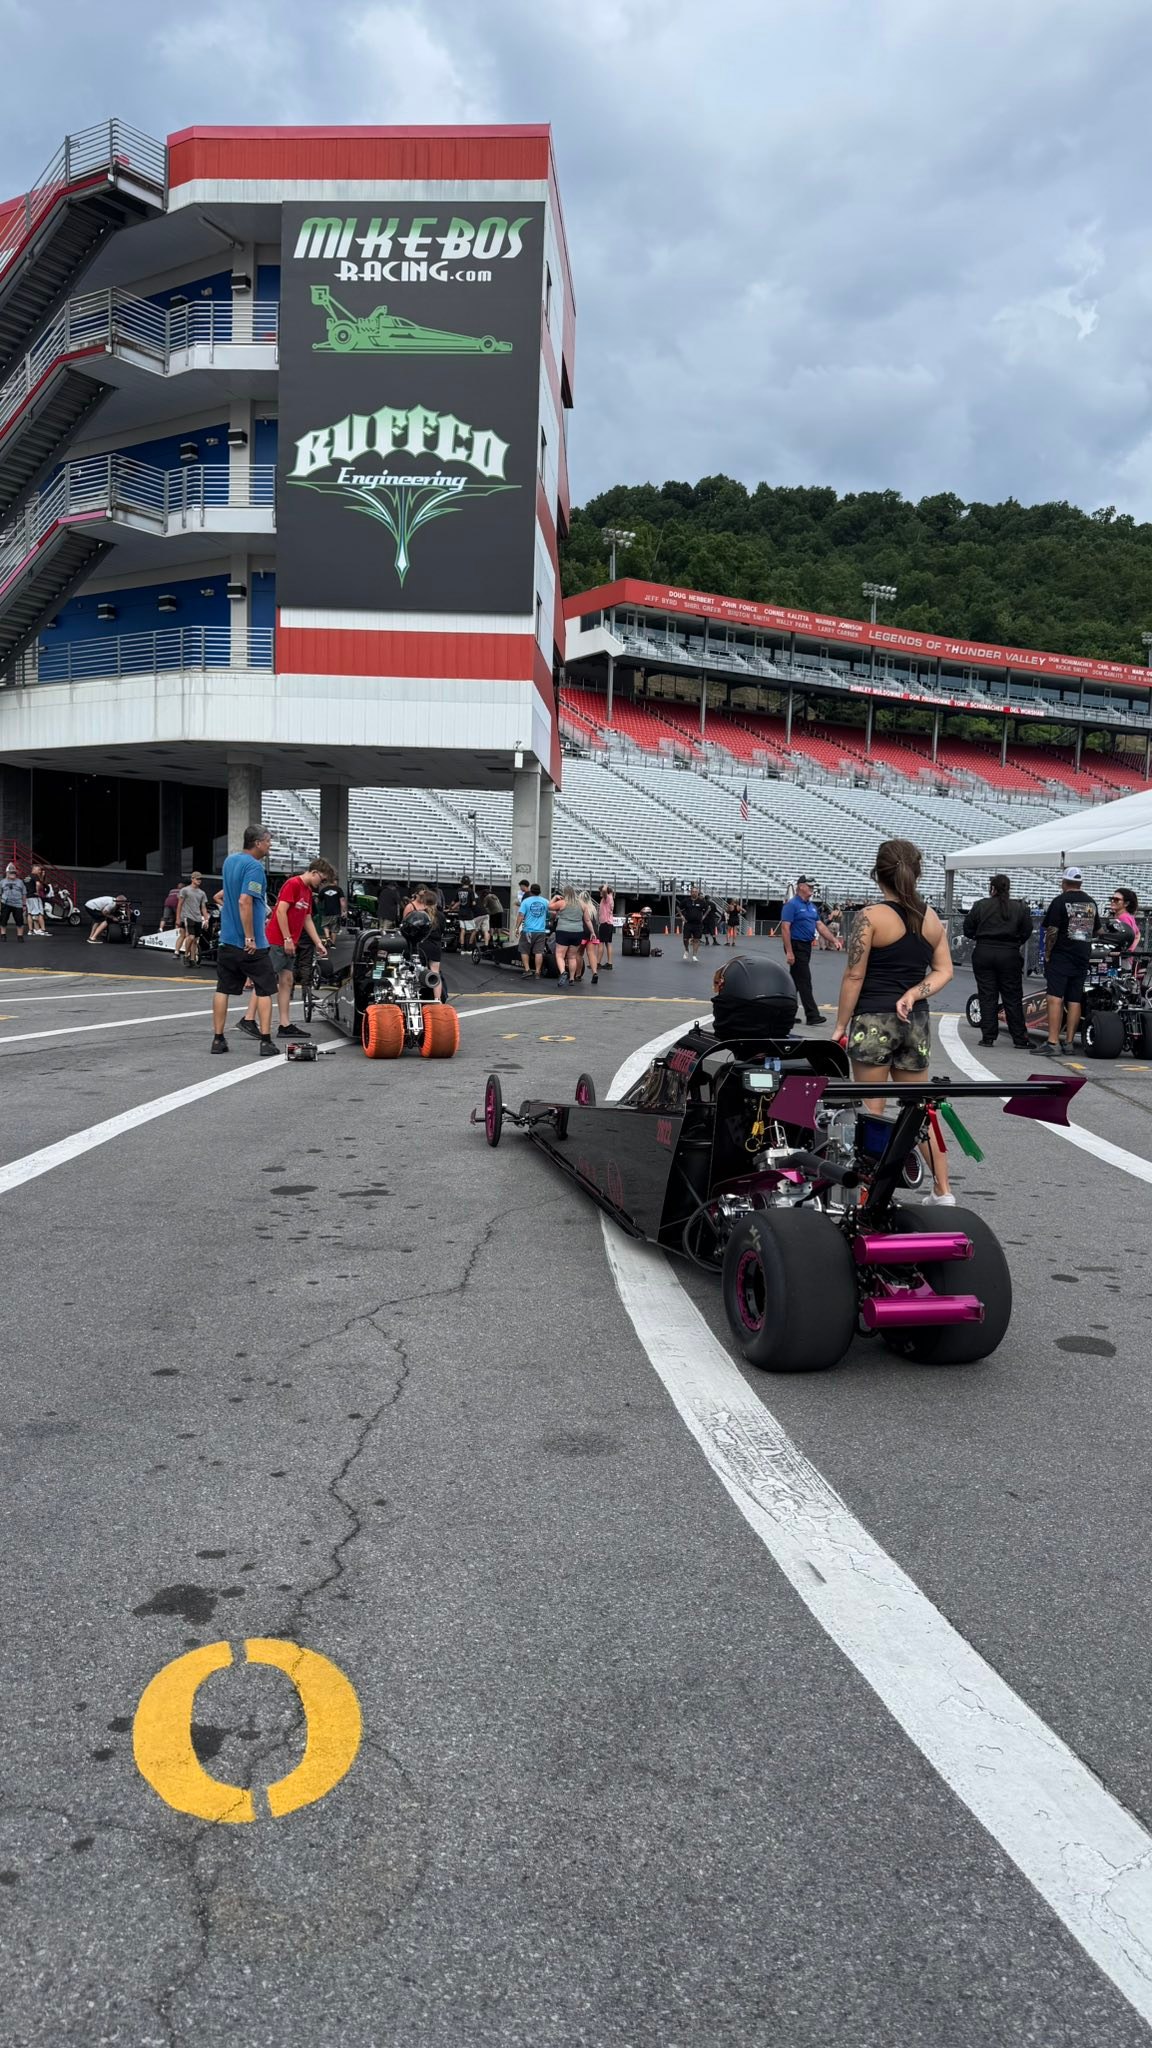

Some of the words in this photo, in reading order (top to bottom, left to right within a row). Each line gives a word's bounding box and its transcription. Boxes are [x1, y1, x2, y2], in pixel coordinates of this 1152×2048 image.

[336, 466, 468, 491] Engineering
[668, 591, 686, 600] DOUG
[721, 600, 737, 609] JOHN
[739, 603, 758, 612] FORCE
[868, 630, 923, 648] LEGENDS
[926, 640, 942, 650] OF
[944, 644, 1002, 660] THUNDER
[1005, 652, 1046, 666] VALLEY
